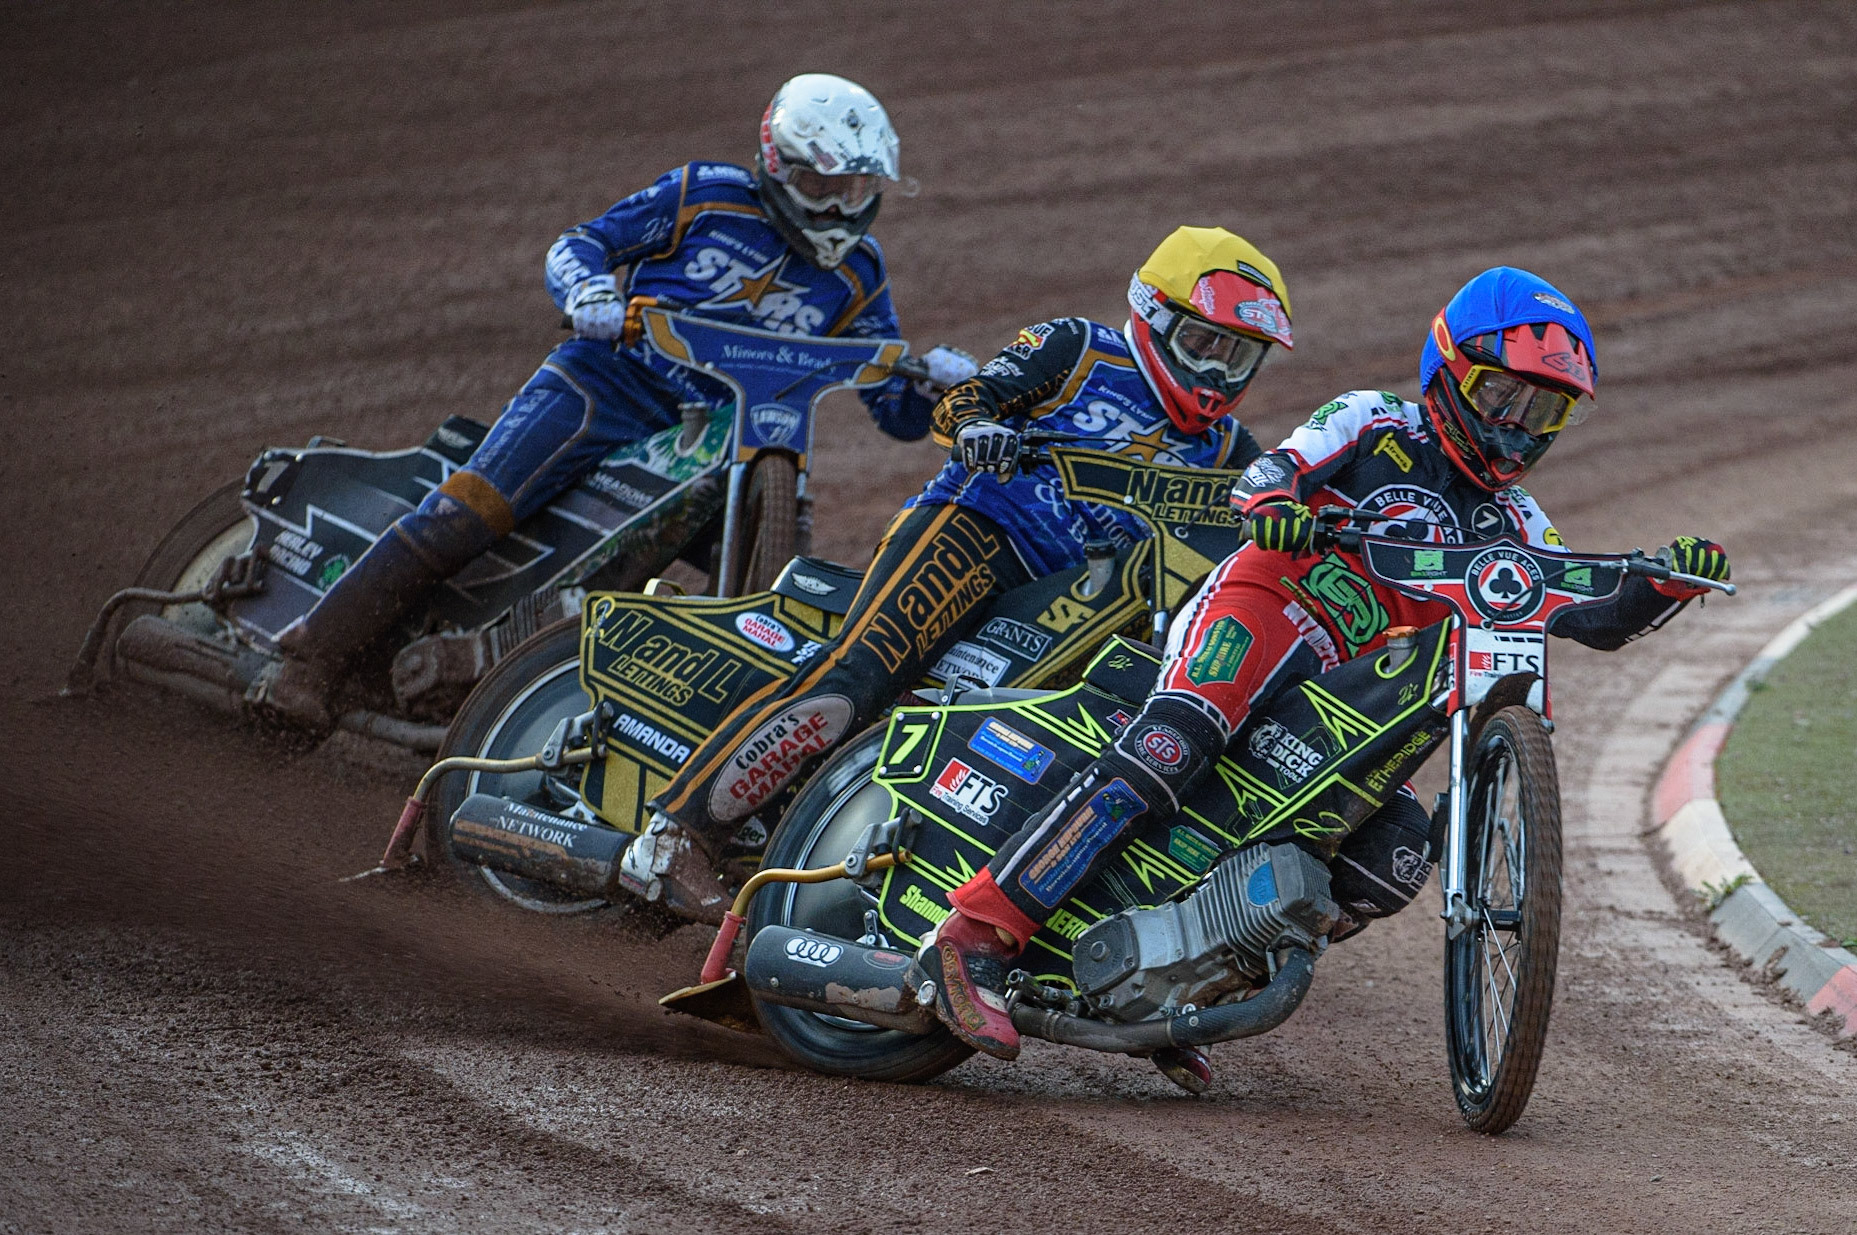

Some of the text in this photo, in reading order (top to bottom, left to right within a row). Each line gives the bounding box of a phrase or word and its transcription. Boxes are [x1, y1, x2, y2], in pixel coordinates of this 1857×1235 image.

[1130, 468, 1160, 505] N
[1374, 491, 1416, 508] BELLE
[1422, 496, 1448, 521] VUE
[1470, 551, 1540, 580] BELLE VUE ACES
[860, 512, 1000, 674] N and L
[915, 563, 997, 660] LETTINGS
[742, 624, 777, 649] MAHAL
[744, 618, 785, 643] GARAGE
[986, 618, 1045, 653] GRANTS
[599, 609, 742, 704] N and L
[1493, 652, 1539, 673] FTS
[607, 654, 694, 707] LETTINGS
[612, 713, 692, 764] AMANDA
[729, 711, 829, 800] GARAGE
[735, 713, 800, 770] Cobra's
[889, 724, 930, 765] 7
[1147, 736, 1177, 760] STS
[1281, 732, 1324, 766] KING
[746, 734, 833, 807] MAHAL
[1271, 743, 1314, 778] DICK
[1280, 765, 1303, 784] TOOLS
[1367, 730, 1432, 793] ETHERIDGE
[931, 786, 988, 824] Fire Training Services
[955, 771, 1009, 817] FTS
[498, 815, 578, 848] NETWORK
